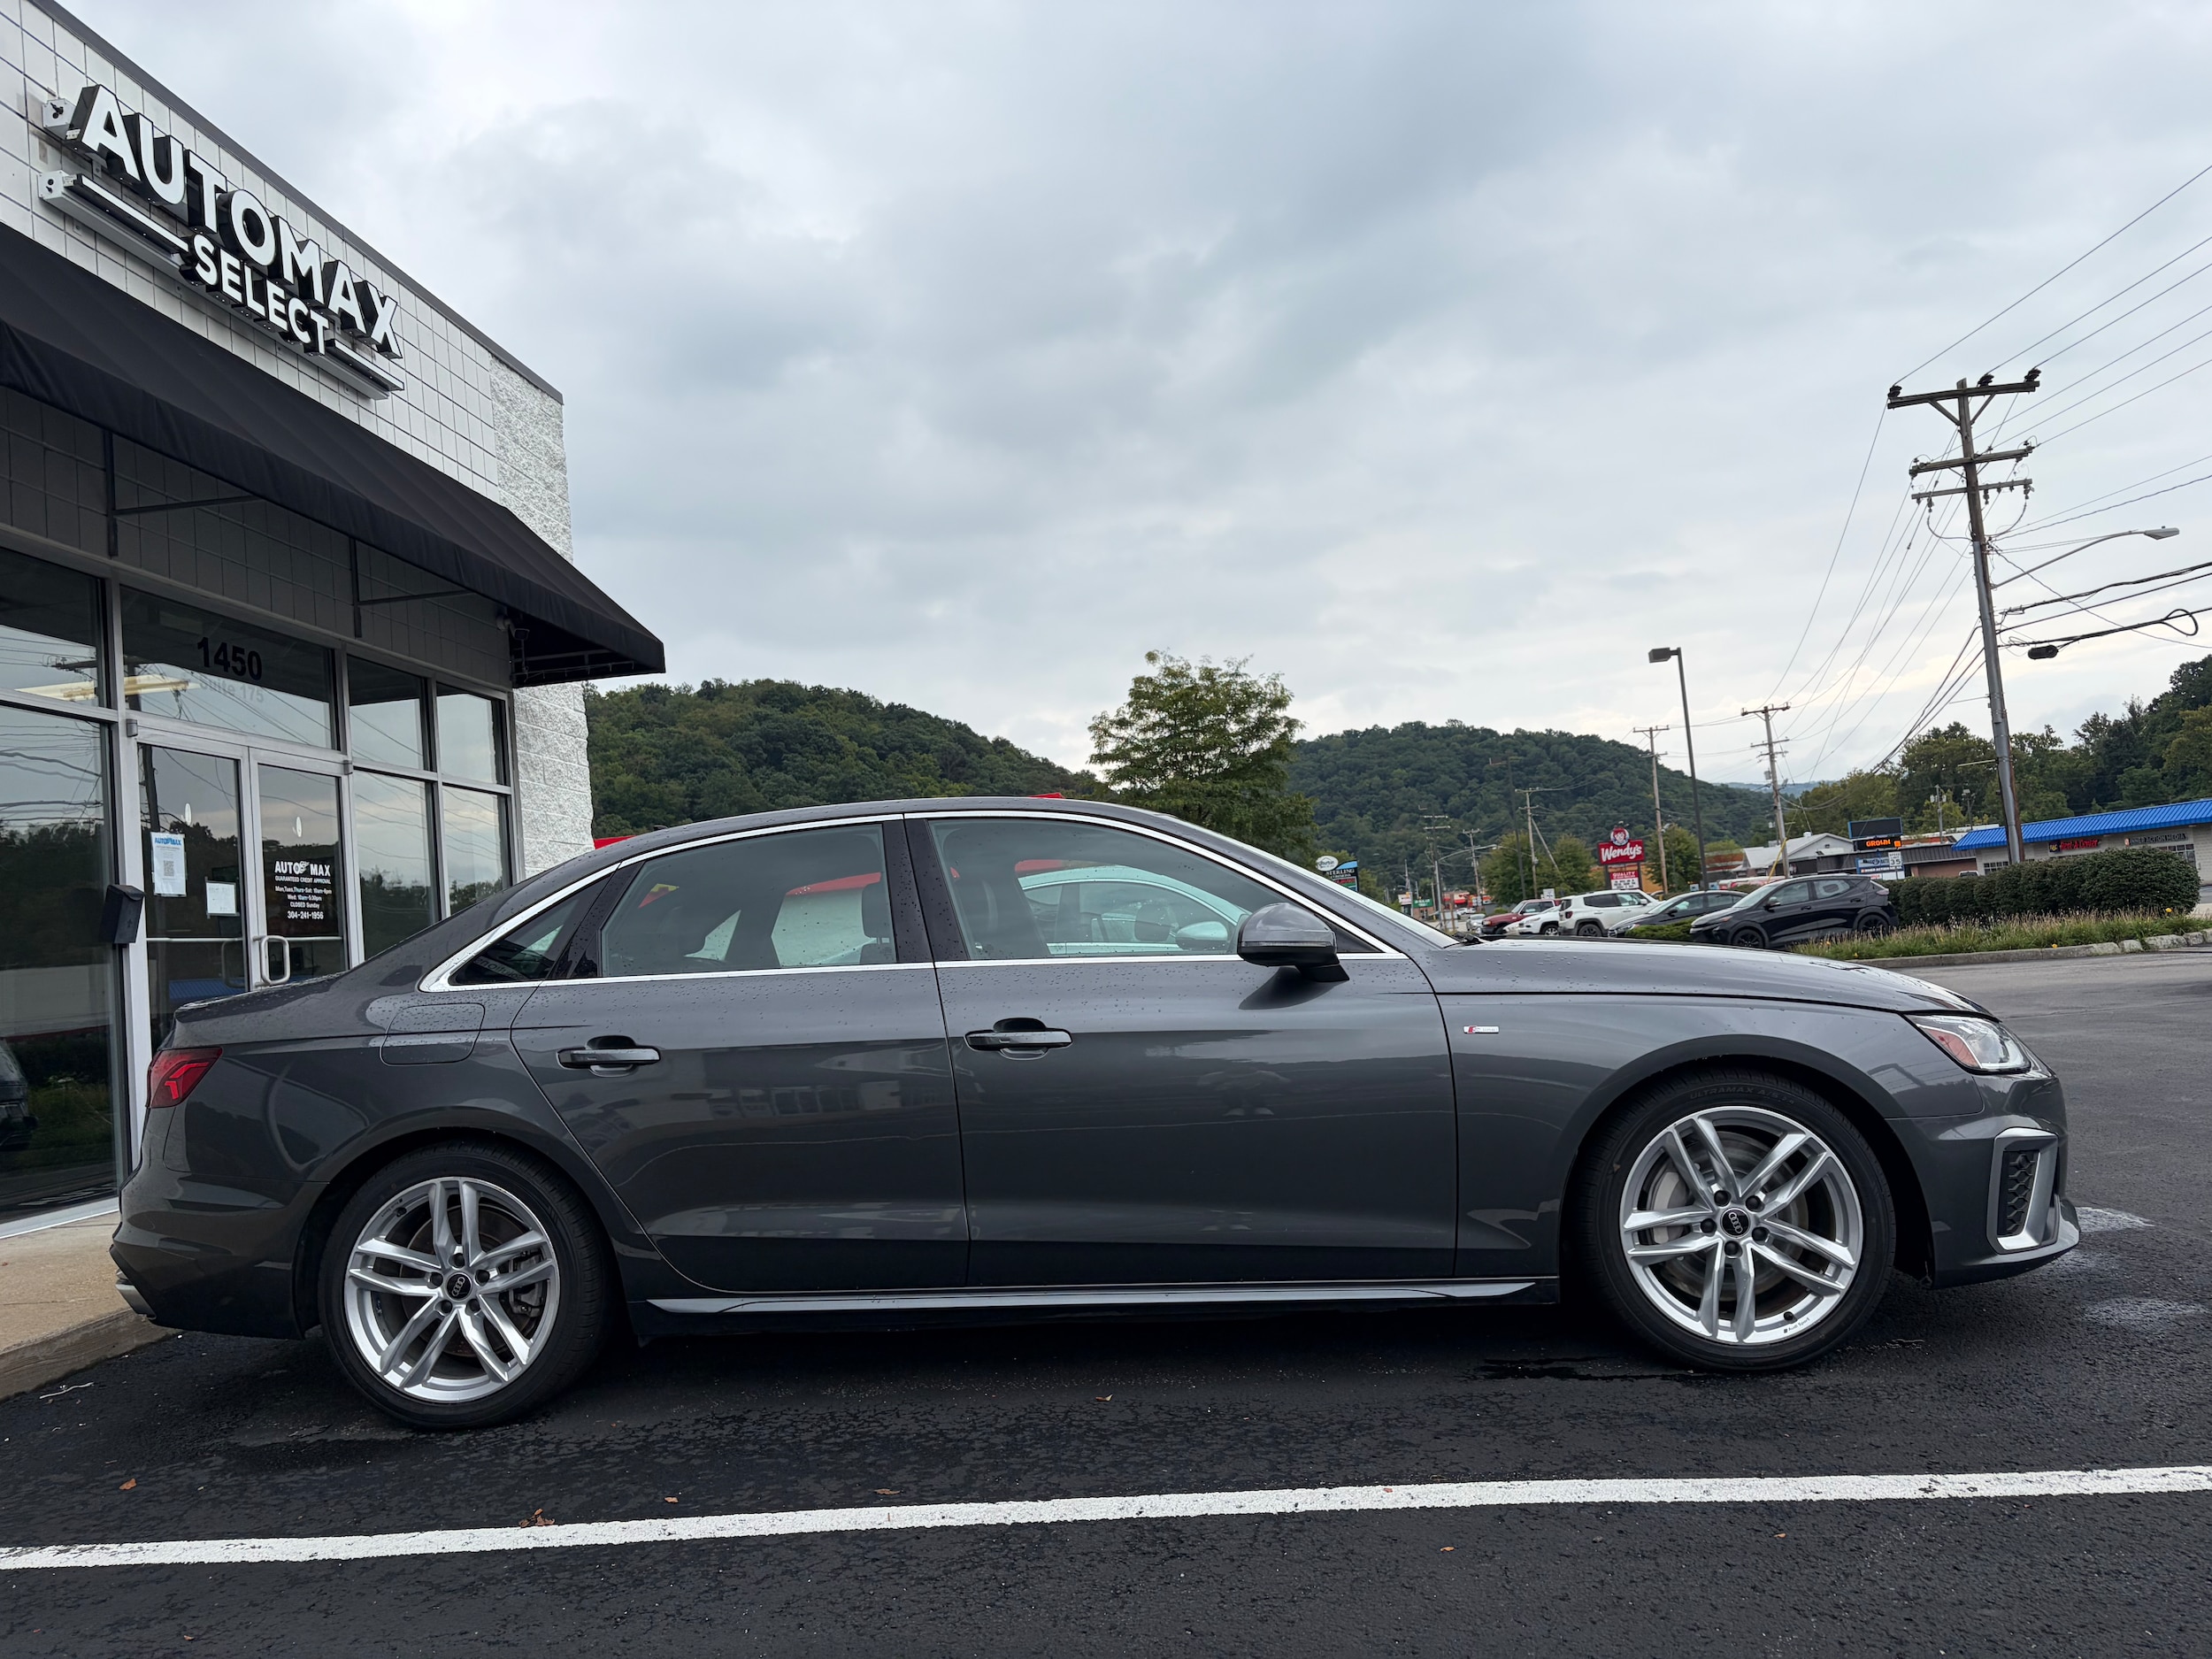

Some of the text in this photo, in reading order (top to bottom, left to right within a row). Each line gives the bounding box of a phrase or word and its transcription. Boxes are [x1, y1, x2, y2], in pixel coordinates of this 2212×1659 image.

[75, 83, 403, 359] AUTOMAX
[187, 233, 329, 357] SELECT
[196, 636, 263, 681] 1450
[240, 684, 265, 703] 175
[1601, 842, 1642, 862] Wendy's
[274, 861, 331, 877] AUTO MAX
[287, 910, 325, 920] 304-241-1956
[1689, 1086, 1755, 1100] ULTRAMAX
